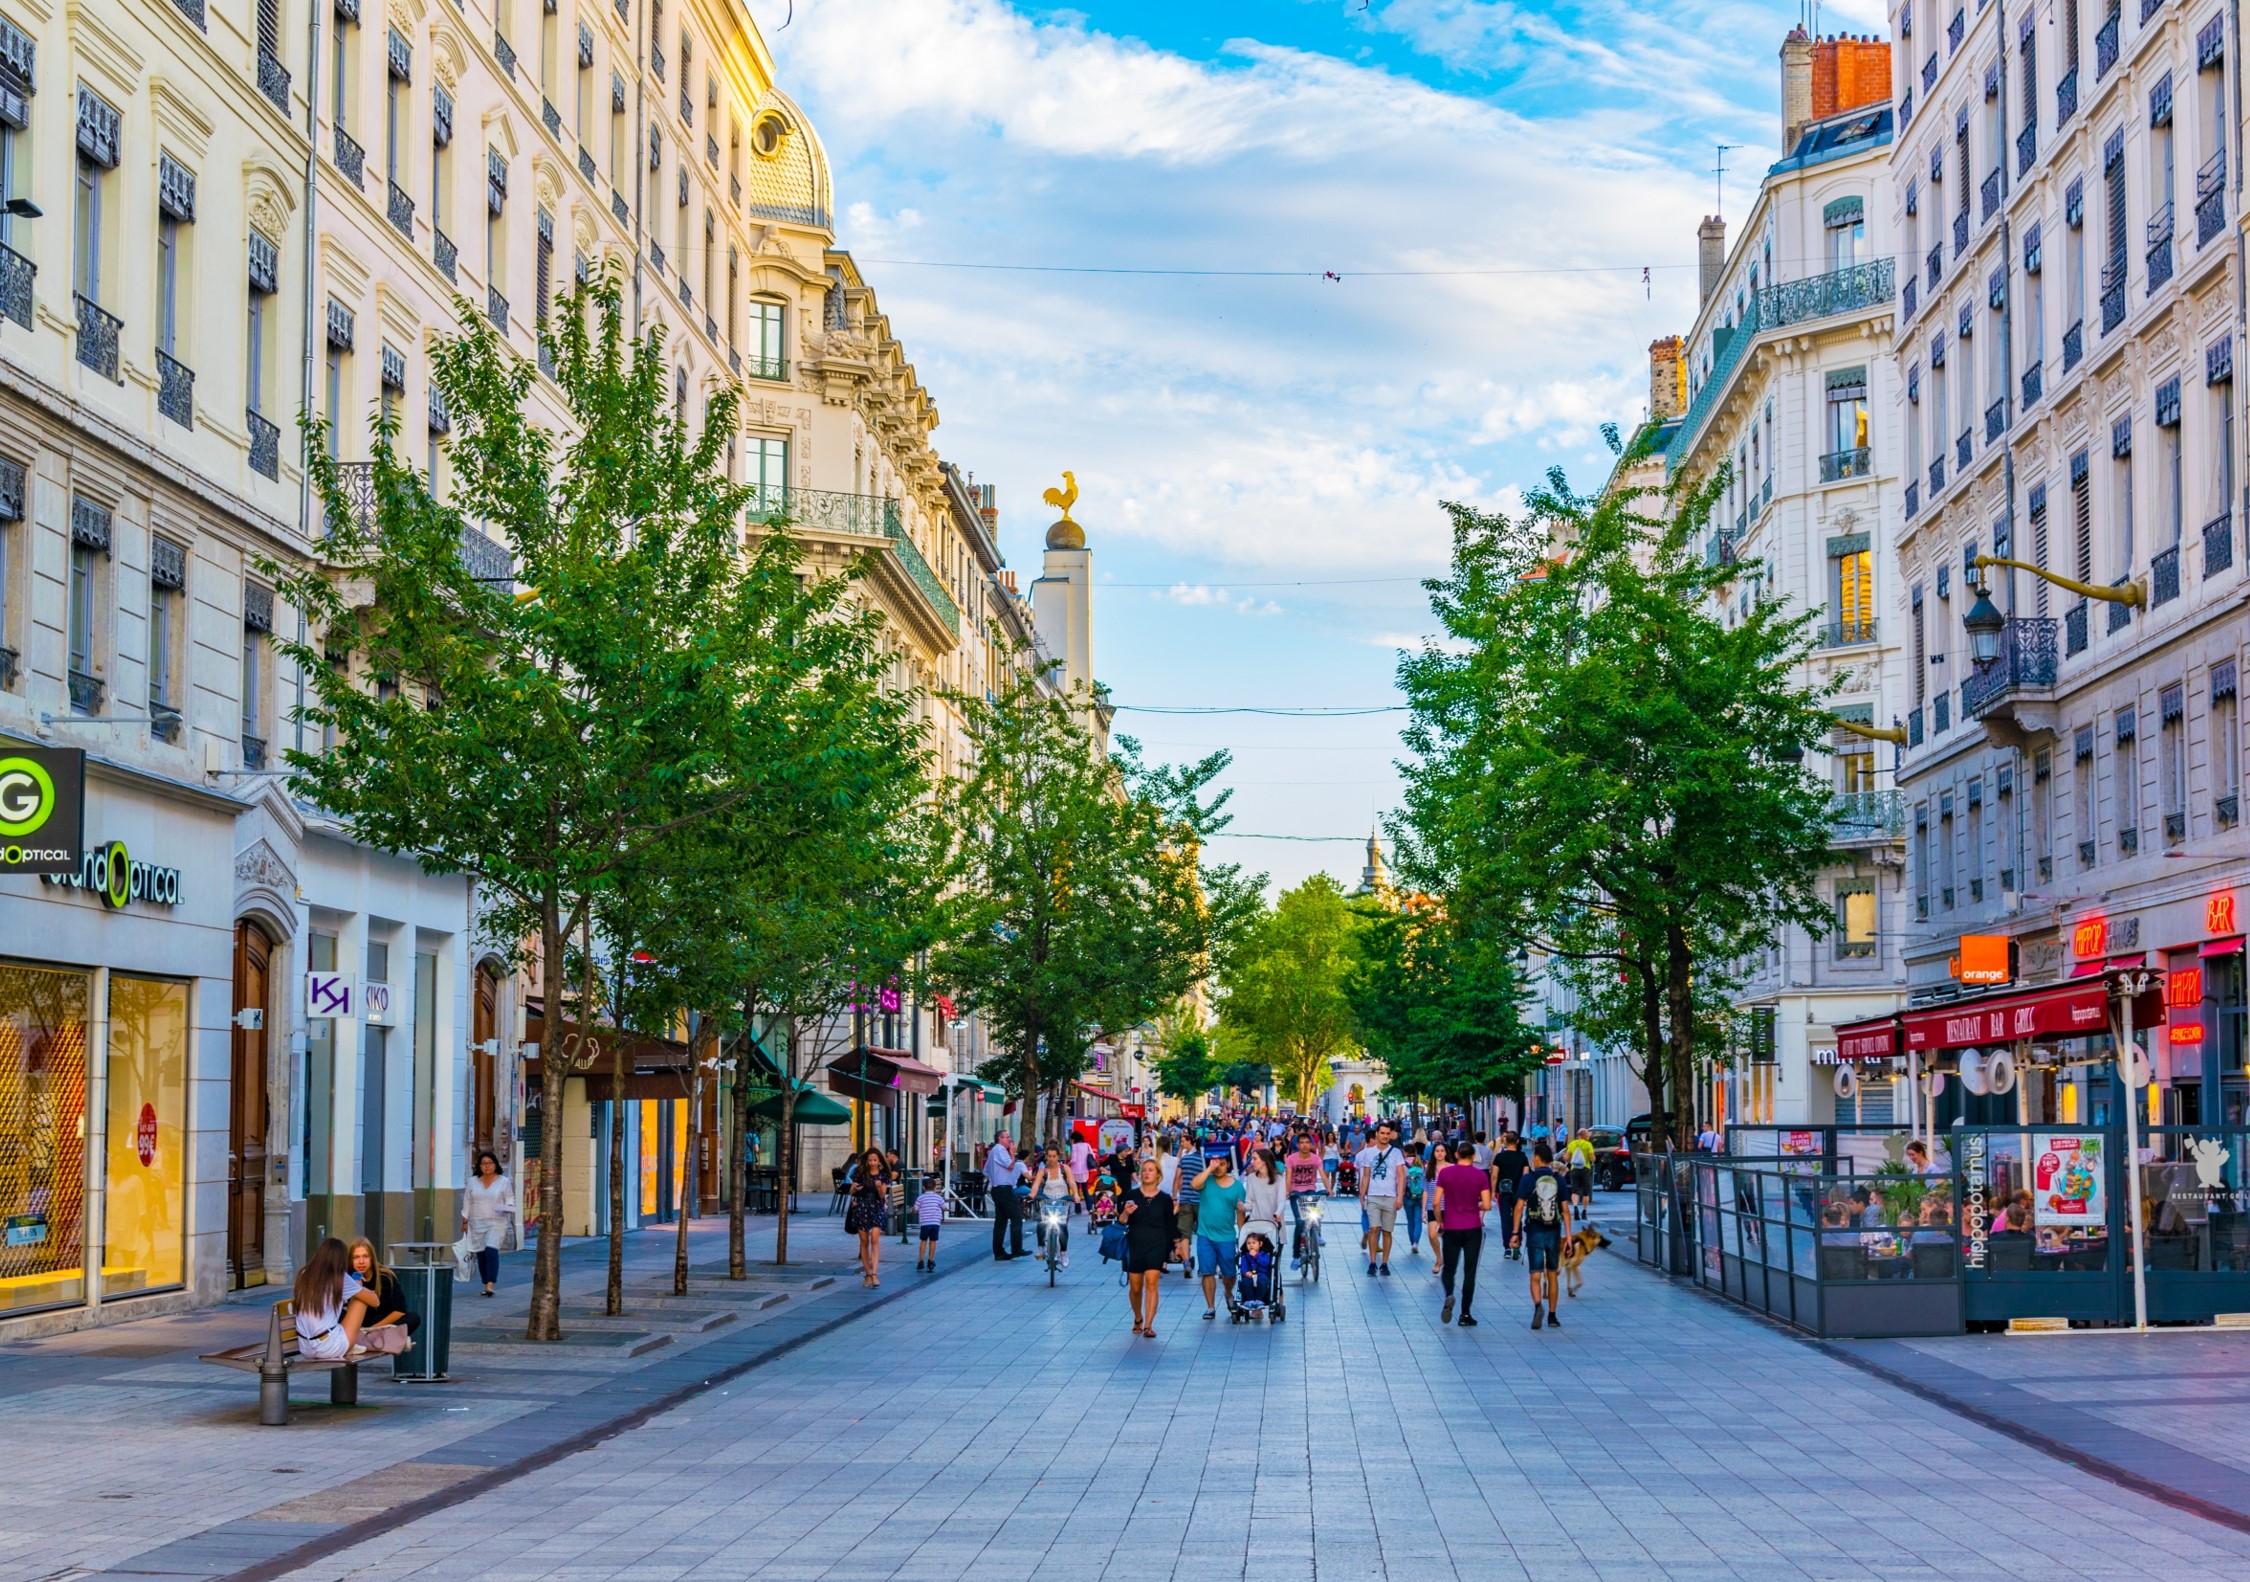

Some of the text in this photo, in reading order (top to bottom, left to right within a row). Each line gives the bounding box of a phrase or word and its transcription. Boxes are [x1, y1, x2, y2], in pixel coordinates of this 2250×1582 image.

[2206, 897, 2233, 933] BAR
[1963, 970, 2003, 981] orange
[1946, 1006, 2036, 1043] RESTAURANT BAR GRILL
[139, 1135, 155, 1156] 99€
[1295, 1166, 1314, 1174] NYC
[1965, 1137, 1988, 1268] hippopotamus
